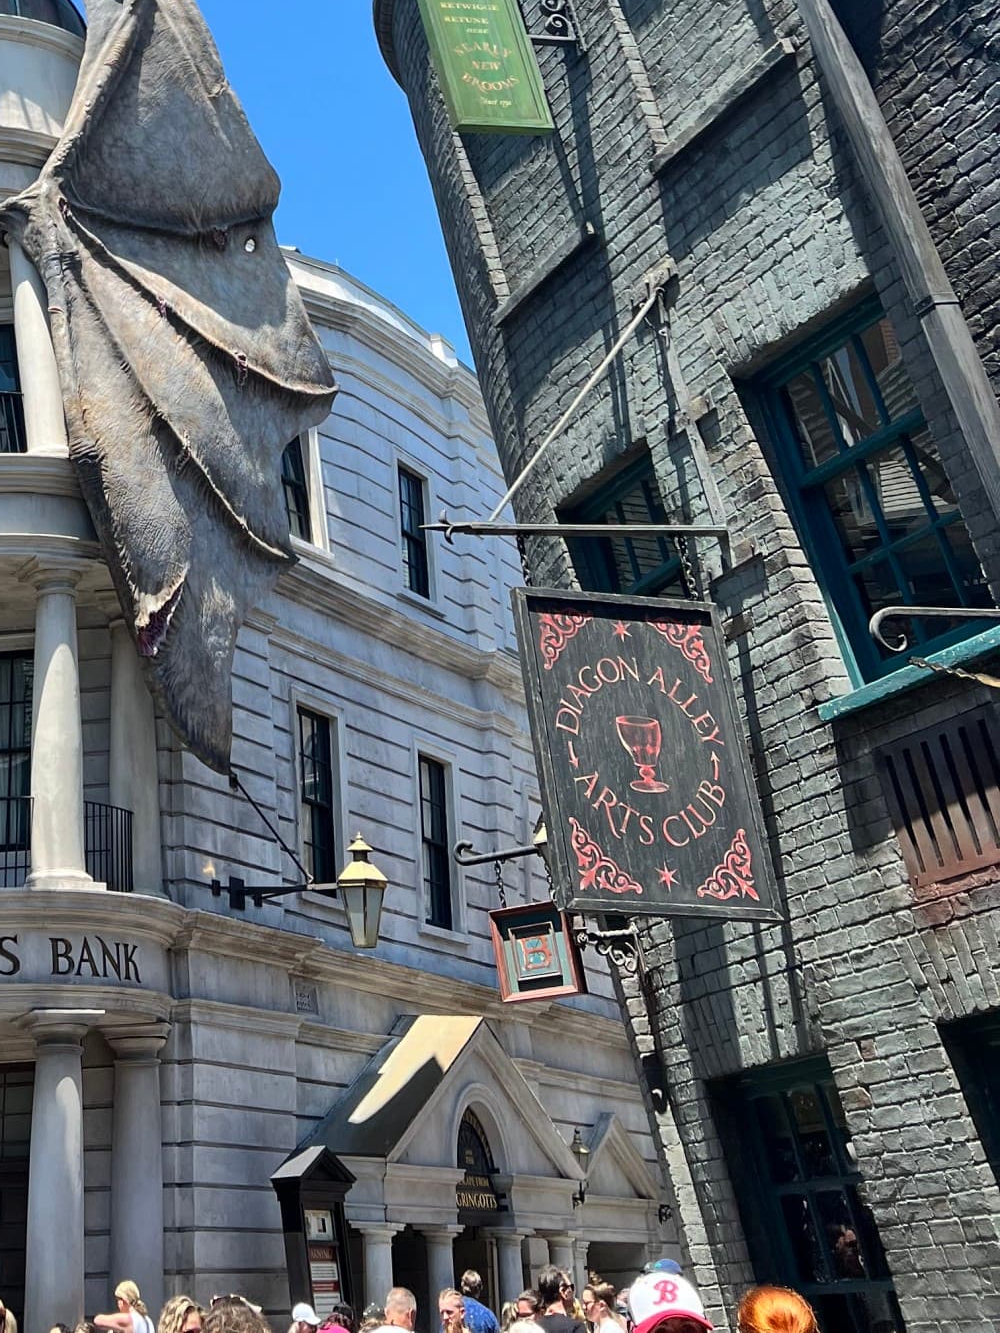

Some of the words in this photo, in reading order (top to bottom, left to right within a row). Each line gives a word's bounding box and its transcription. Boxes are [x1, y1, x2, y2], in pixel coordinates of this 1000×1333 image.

[471, 60, 501, 70] NEW
[461, 71, 520, 95] BROOMS
[555, 655, 641, 736] DIAGON
[646, 665, 726, 747] ALLEY
[574, 770, 655, 846] ARTS
[662, 779, 727, 848] CLUB
[48, 935, 142, 984] BANK
[456, 1192, 498, 1209] GRINGOTTS
[653, 1279, 679, 1306] B
